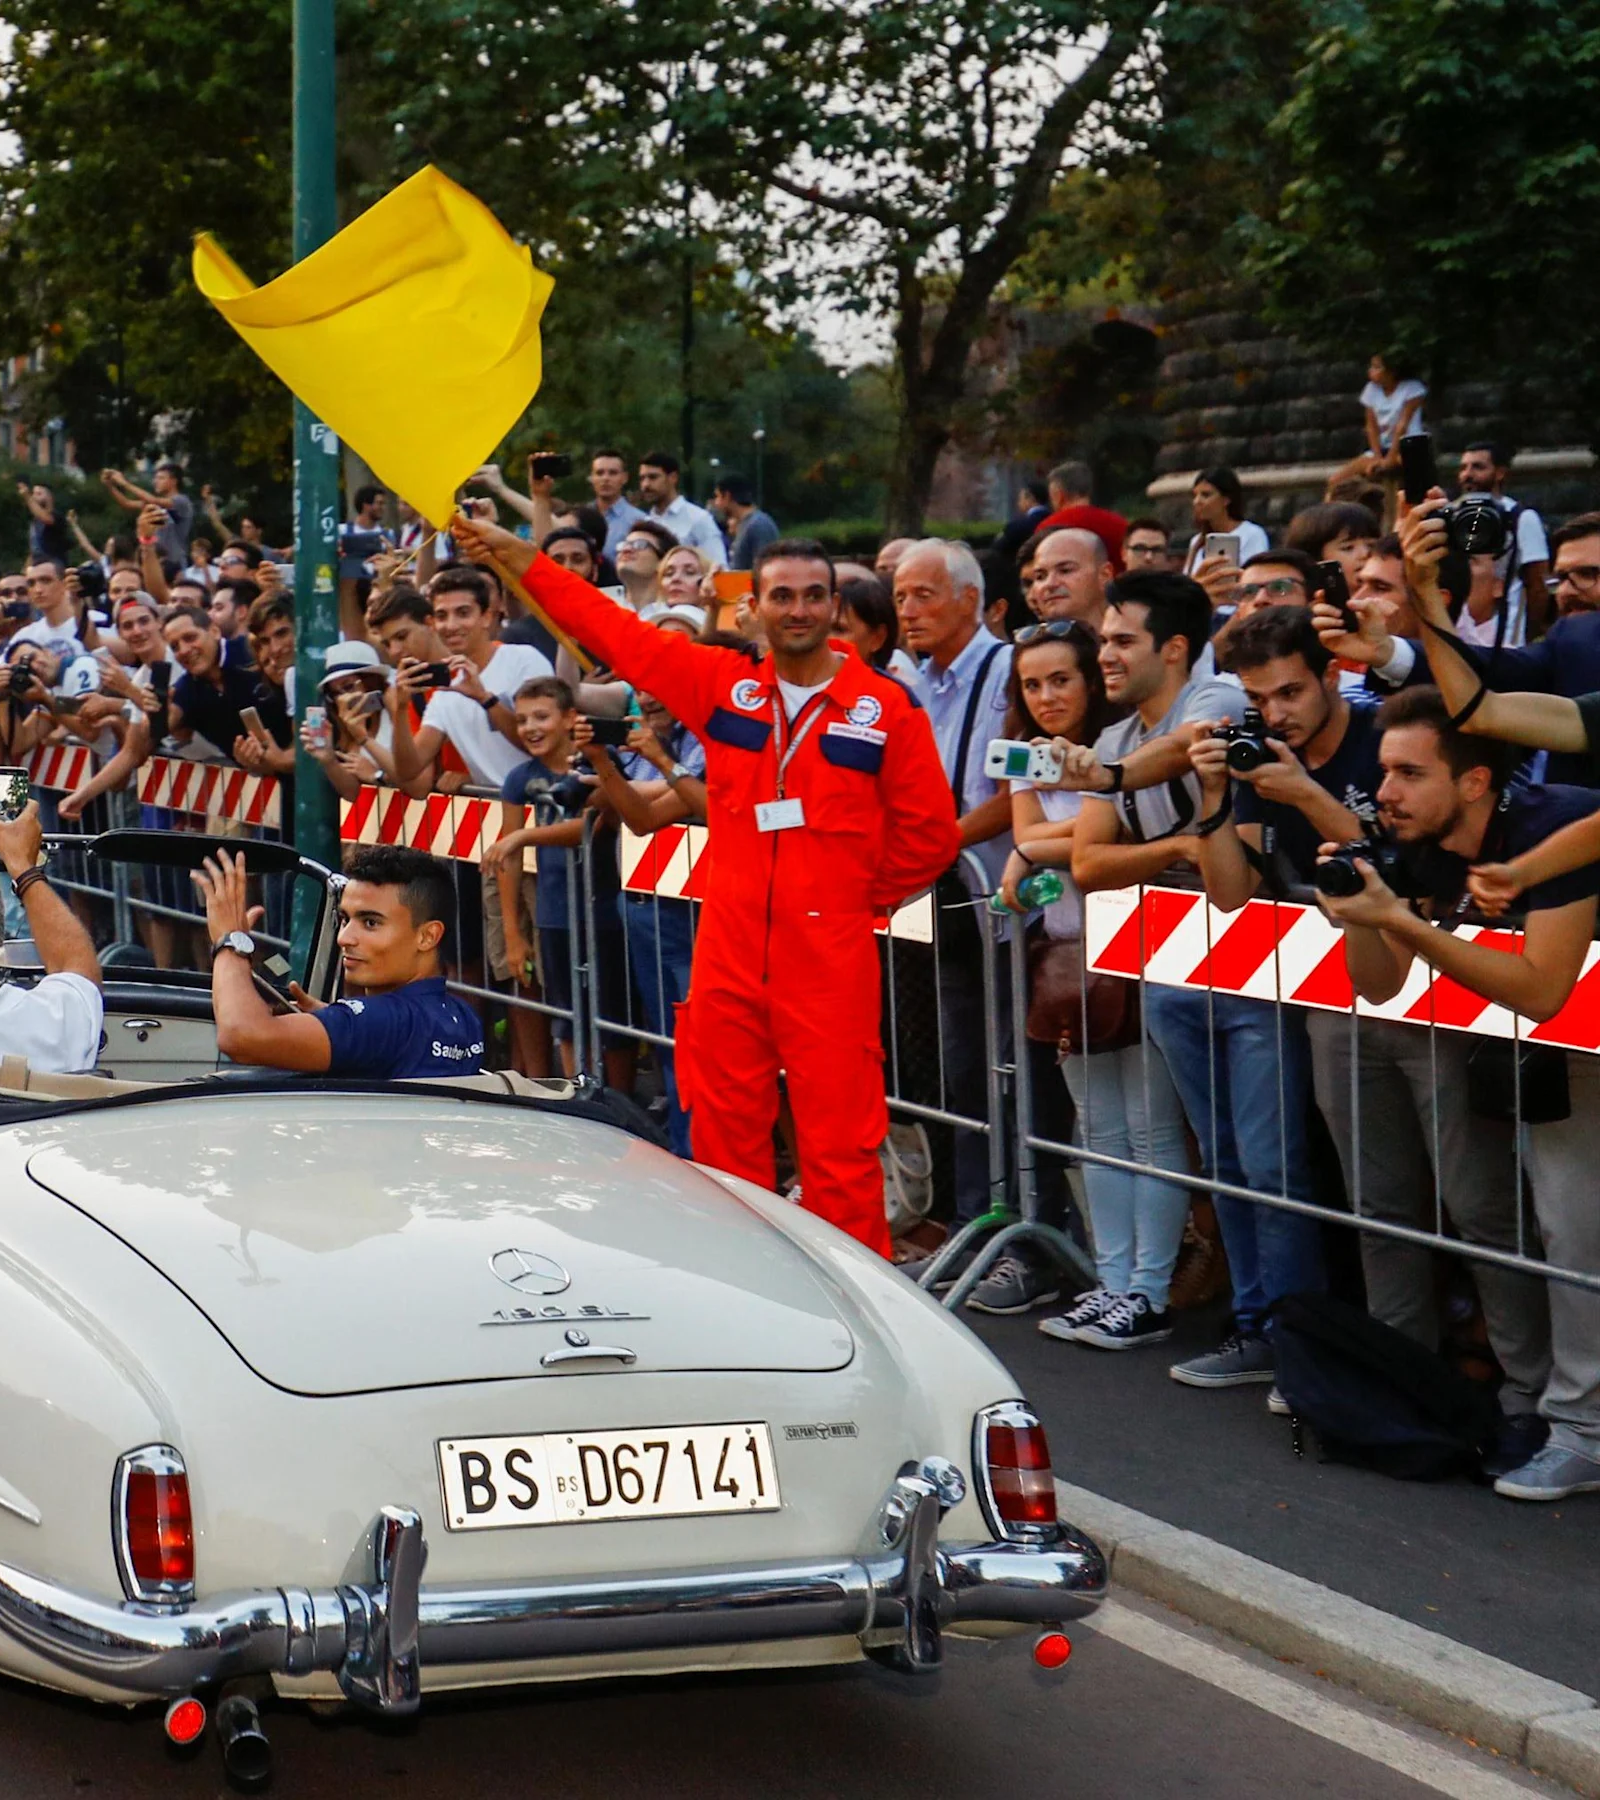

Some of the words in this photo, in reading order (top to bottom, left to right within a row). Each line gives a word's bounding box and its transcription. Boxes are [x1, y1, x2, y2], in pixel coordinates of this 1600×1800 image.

[78, 669, 91, 689] 2
[459, 1448, 539, 1514] BS
[556, 1475, 578, 1493] BS
[578, 1436, 765, 1507] D67141
